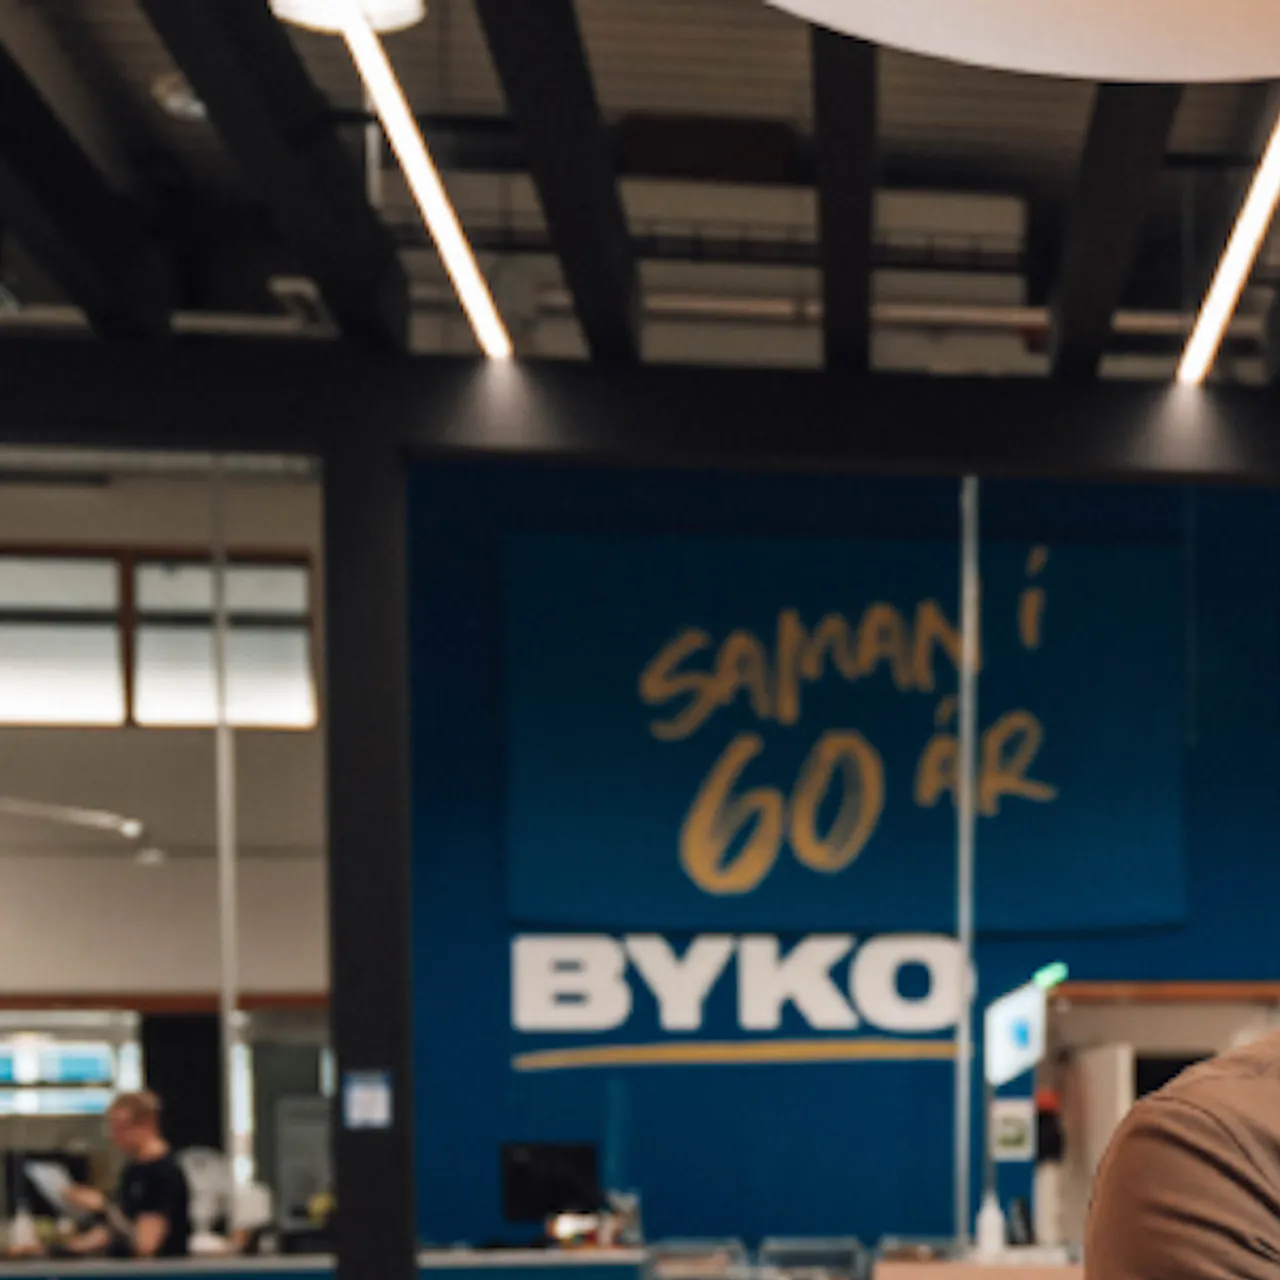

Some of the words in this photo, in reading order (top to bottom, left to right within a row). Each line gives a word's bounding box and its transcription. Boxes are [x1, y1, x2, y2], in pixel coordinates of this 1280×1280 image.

[639, 599, 982, 741] SAMAN
[677, 729, 886, 895] 60
[912, 694, 1058, 816] ÁR
[510, 932, 978, 1033] BYKO
